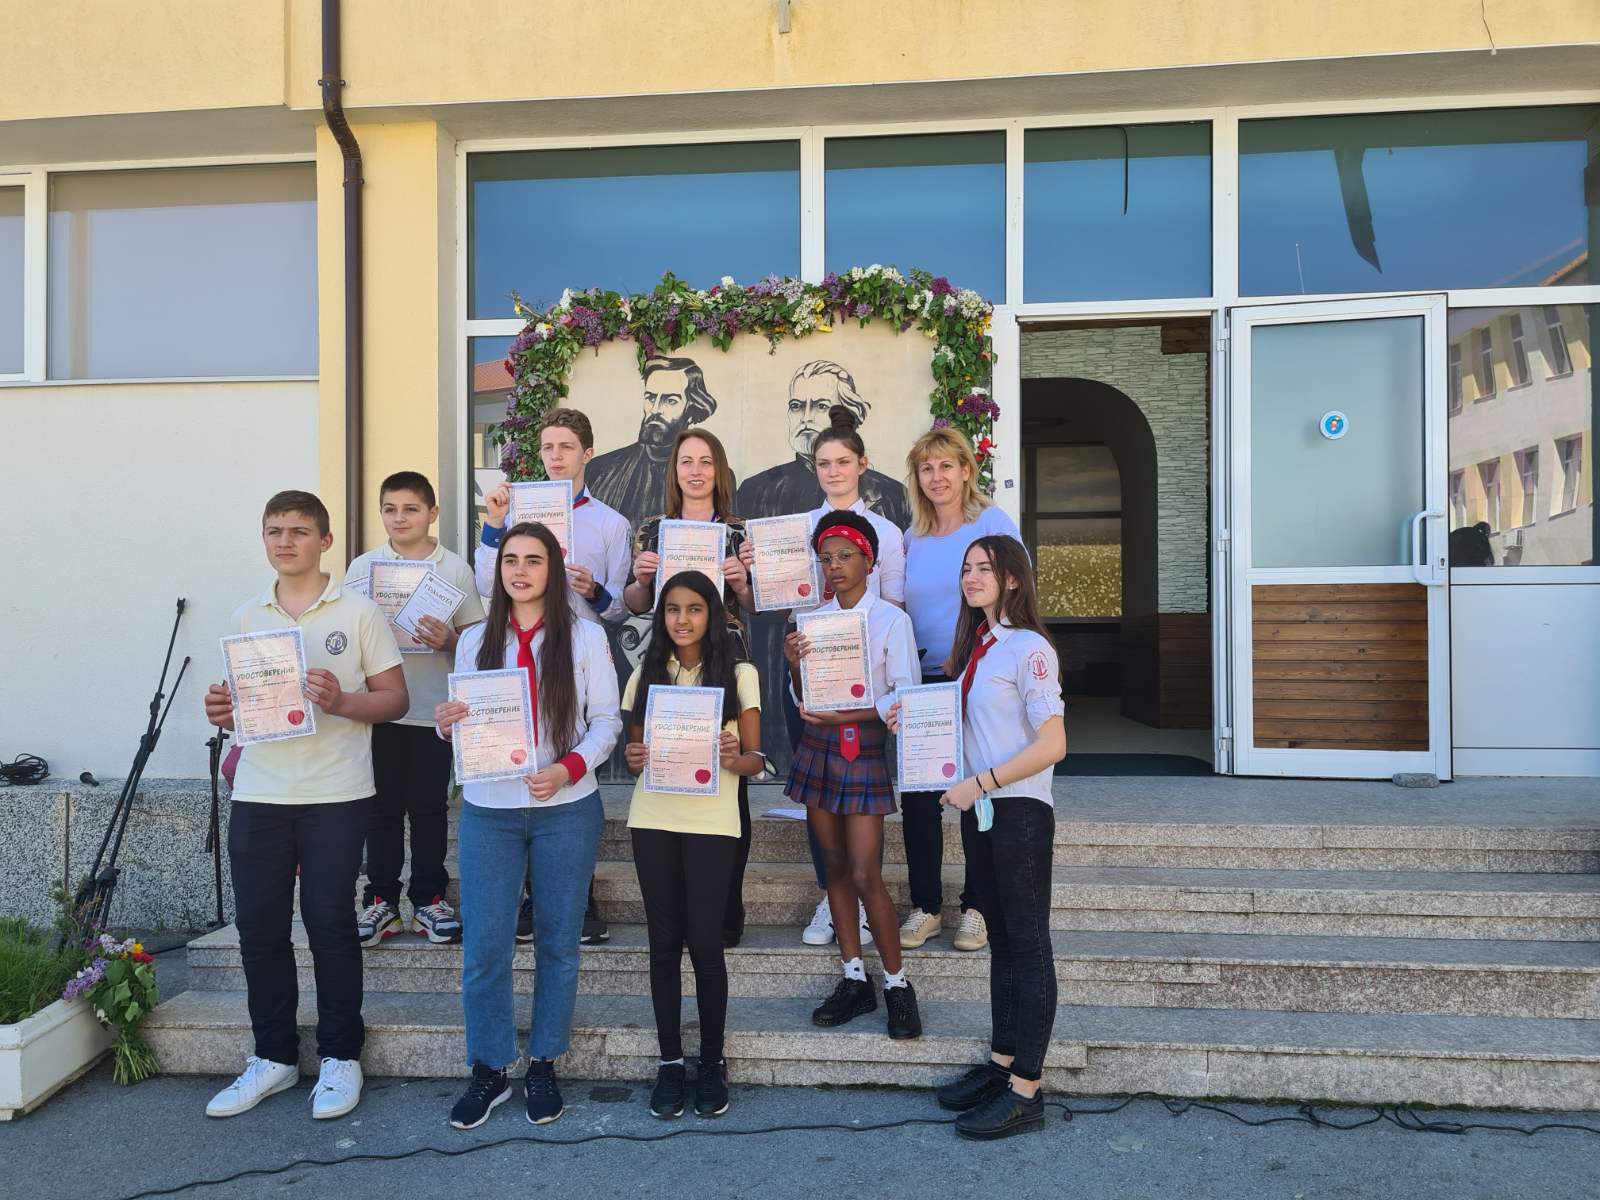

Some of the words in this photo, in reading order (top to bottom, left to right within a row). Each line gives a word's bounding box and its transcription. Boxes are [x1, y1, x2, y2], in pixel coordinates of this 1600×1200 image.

[665, 553, 716, 562] УДОСТОВЕРЕНИЕ
[236, 667, 295, 681] УДОСТОВЕРЕНИЕ
[465, 705, 521, 717] ДОСТОВЕРЕНИЕ
[654, 723, 711, 732] УДОСТОВЕРЕНИЕ
[904, 719, 953, 730] УДОСТОВЕРЕНИЕ
